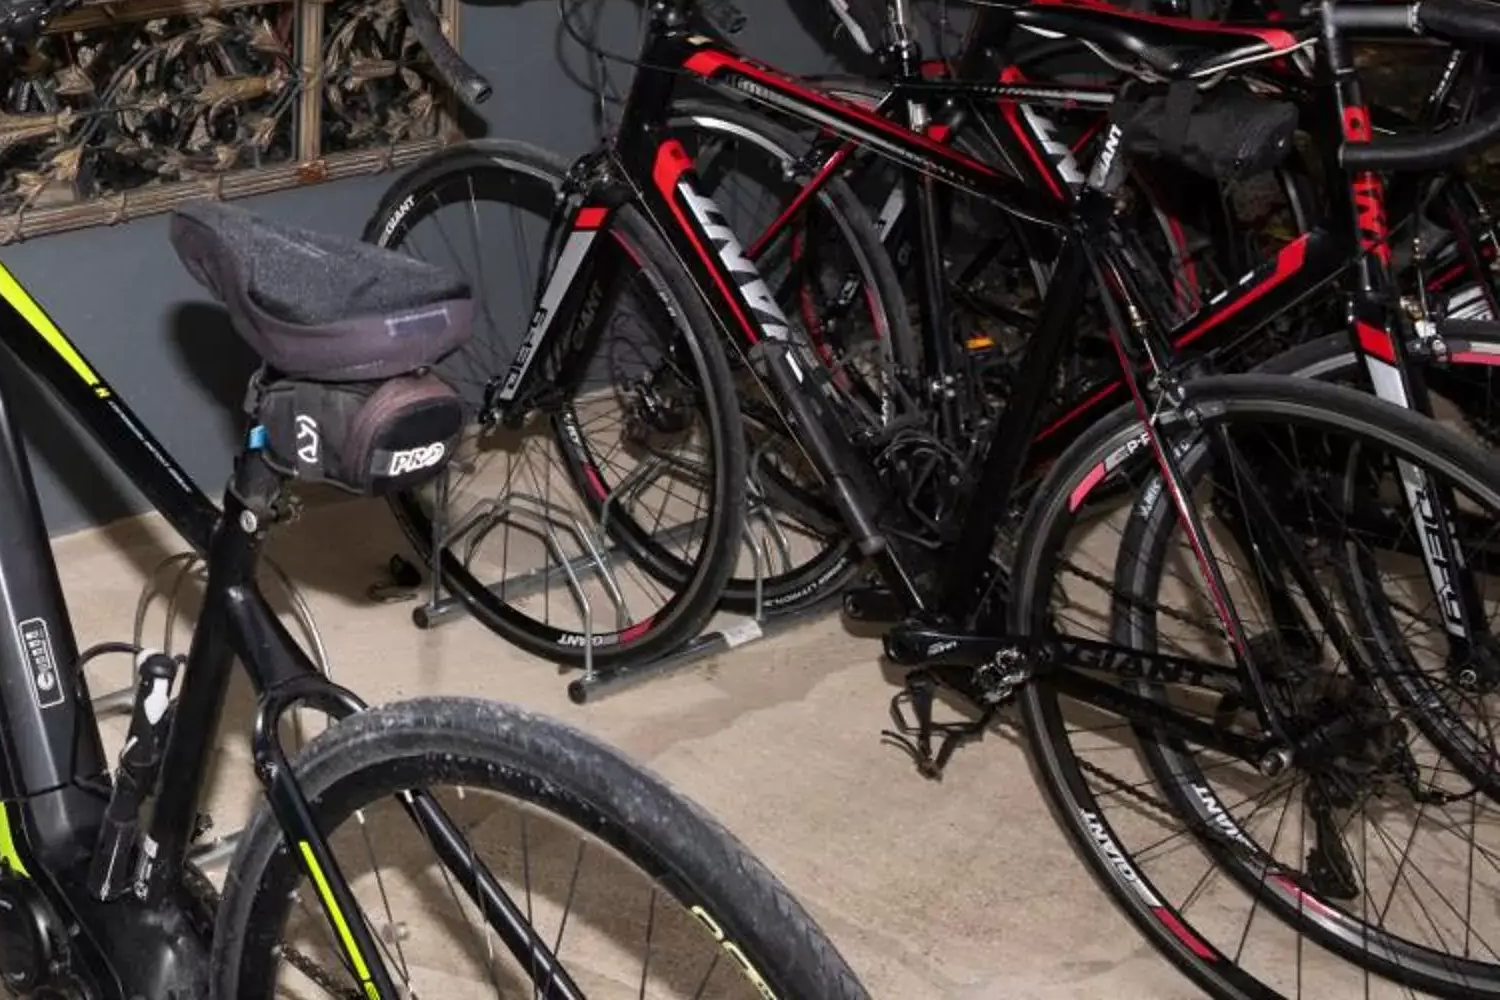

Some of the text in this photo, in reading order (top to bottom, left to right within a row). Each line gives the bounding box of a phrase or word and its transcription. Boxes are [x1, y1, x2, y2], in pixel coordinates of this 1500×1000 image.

[386, 194, 415, 235] GIANT
[678, 182, 802, 346] IANT
[388, 442, 445, 476] PRO
[1412, 488, 1463, 627] DEFY
[558, 632, 603, 647] GANT
[1079, 807, 1136, 882] GIANT
